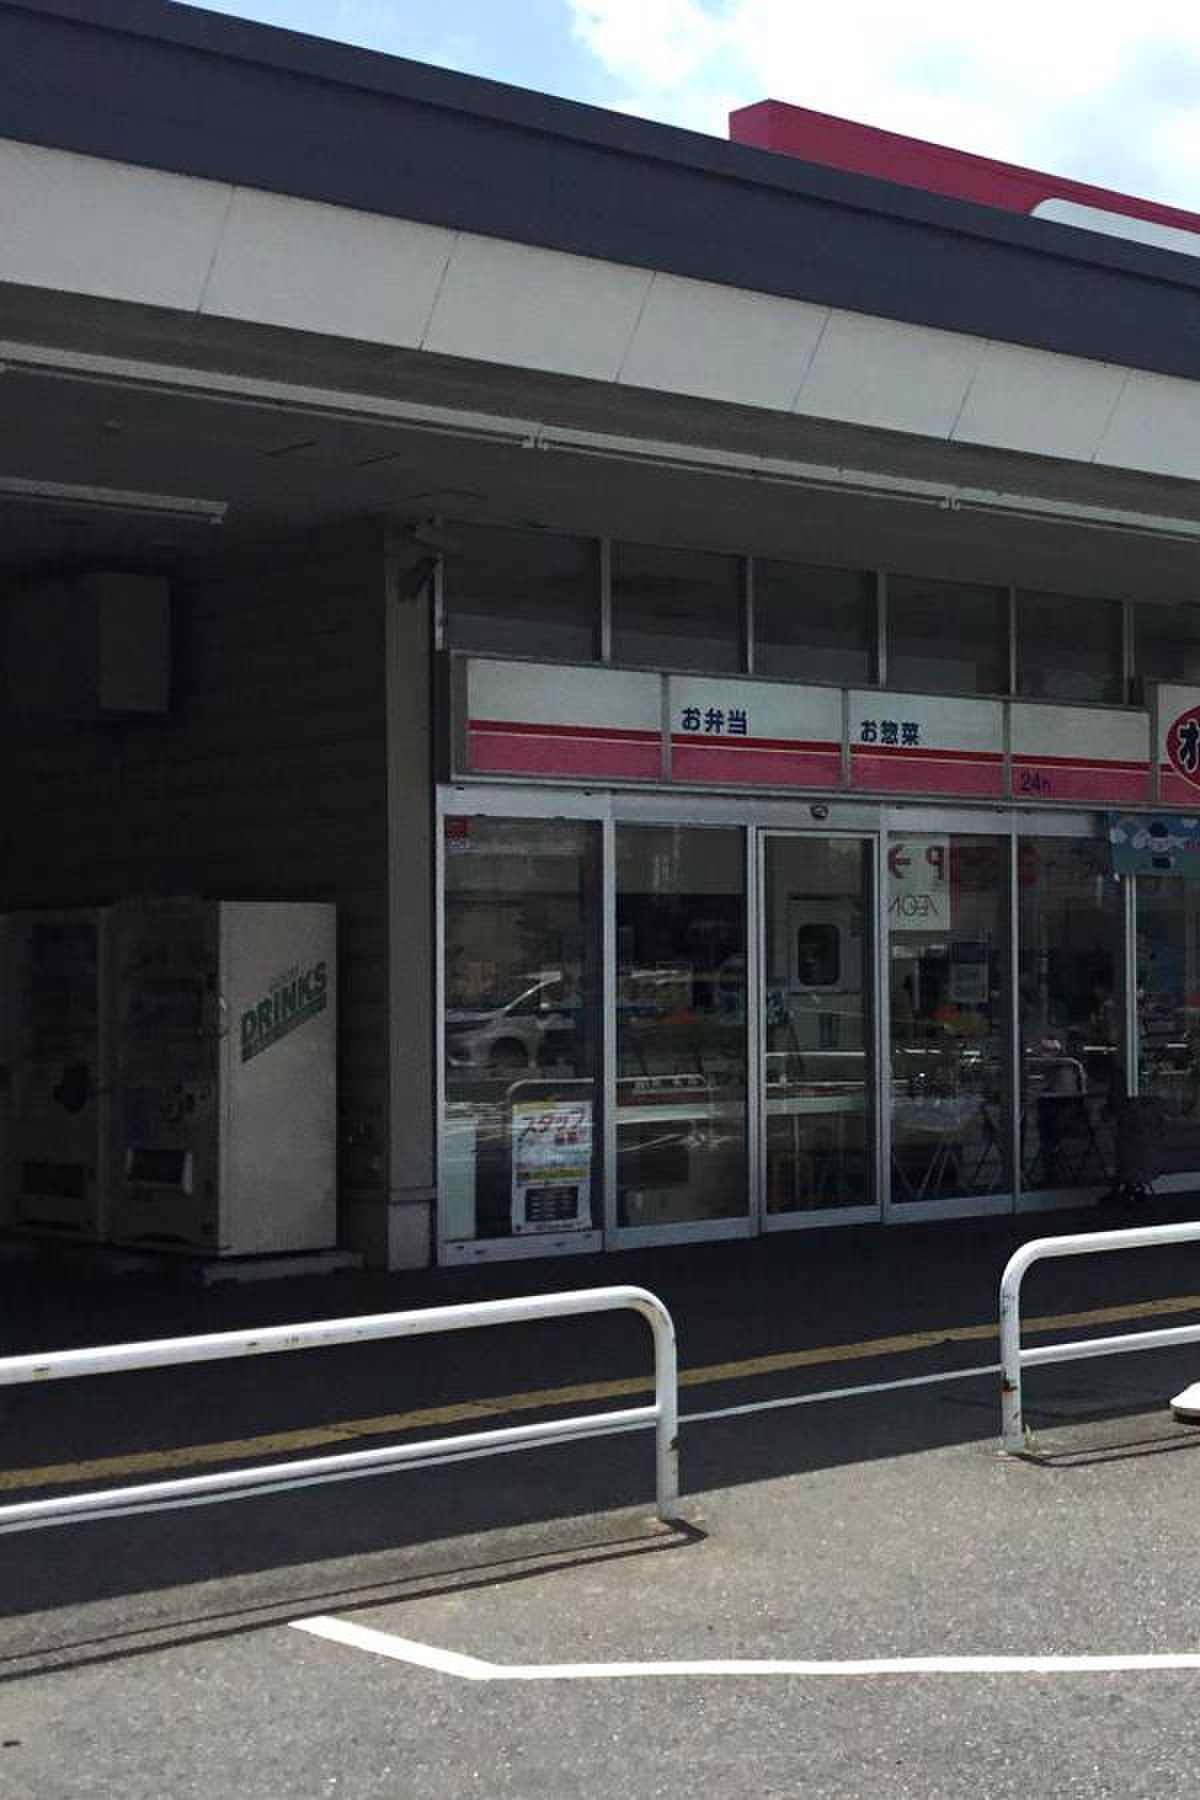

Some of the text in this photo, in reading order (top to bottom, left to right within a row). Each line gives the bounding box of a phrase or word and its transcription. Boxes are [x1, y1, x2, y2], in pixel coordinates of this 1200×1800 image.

[681, 707, 748, 737] お弁当
[860, 720, 921, 746] お惣菜
[241, 960, 327, 1043] DRINKS
